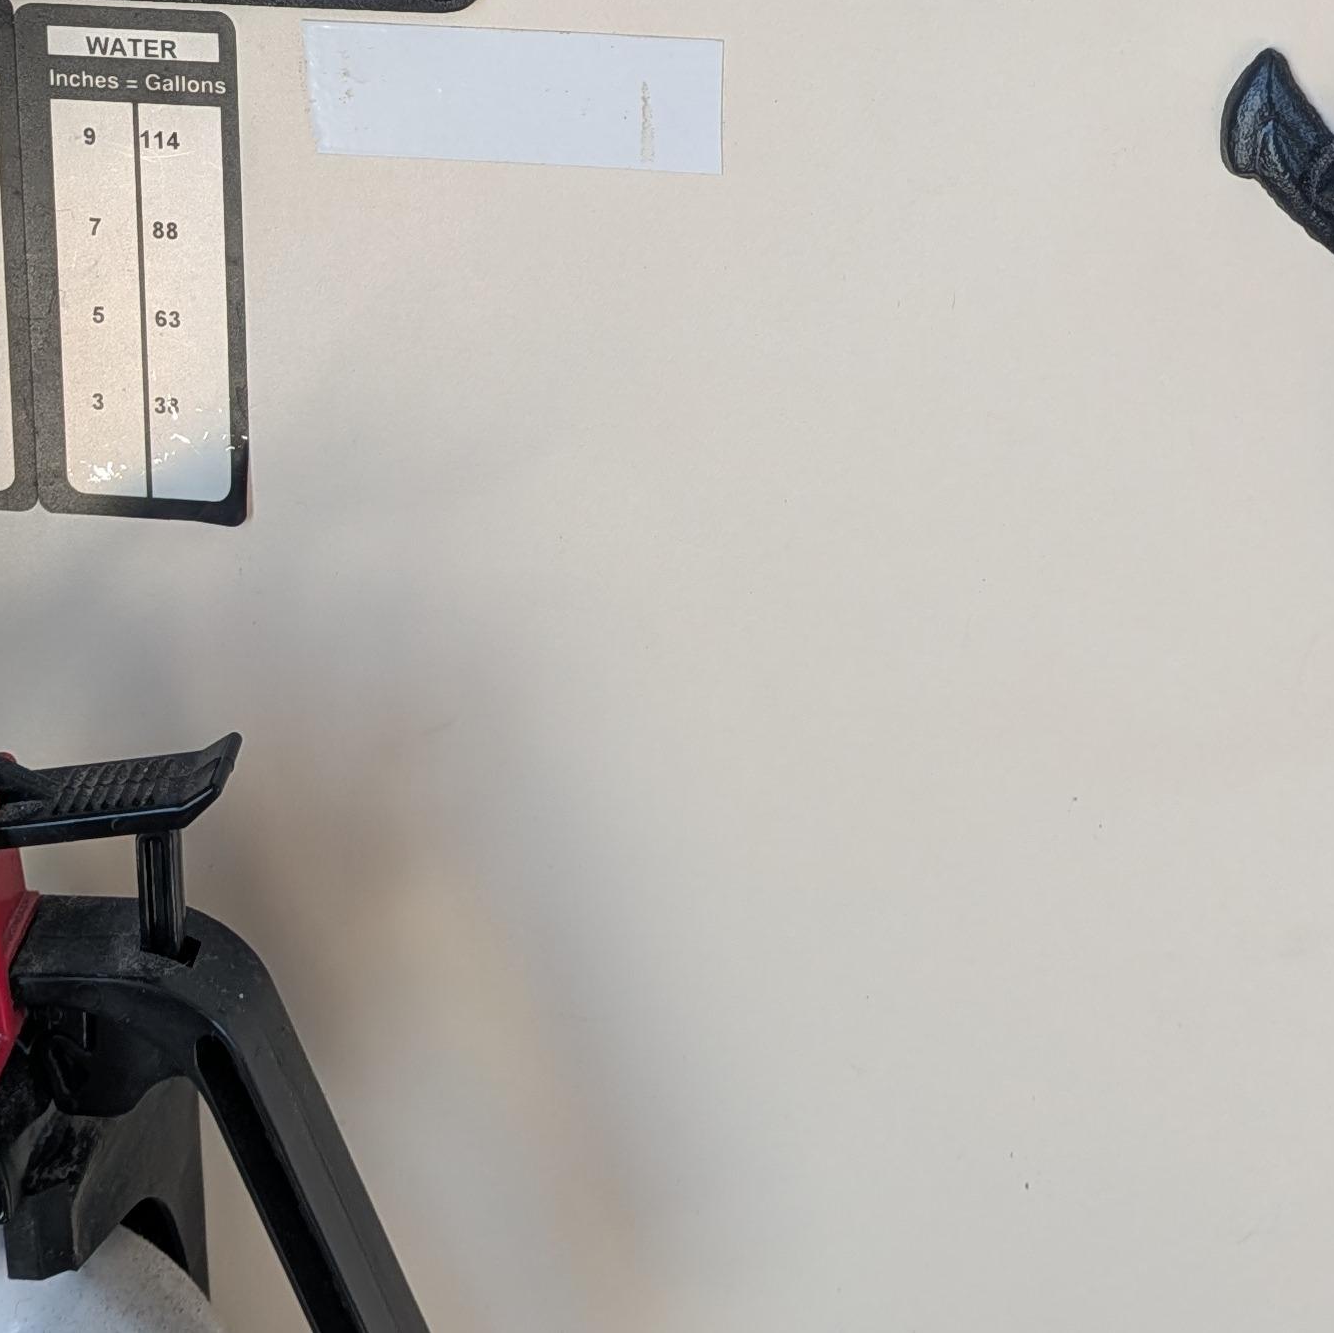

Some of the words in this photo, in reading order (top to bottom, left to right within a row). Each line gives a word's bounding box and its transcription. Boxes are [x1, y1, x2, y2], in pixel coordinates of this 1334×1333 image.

[85, 35, 178, 59] WATER
[49, 68, 119, 90] Inches
[145, 73, 227, 95] Gallons
[83, 127, 96, 146] 9
[140, 129, 181, 150] 114
[88, 217, 102, 236] 7
[152, 220, 179, 240] 88
[92, 305, 105, 324] 5
[154, 309, 181, 329] 63
[92, 392, 104, 411] 3
